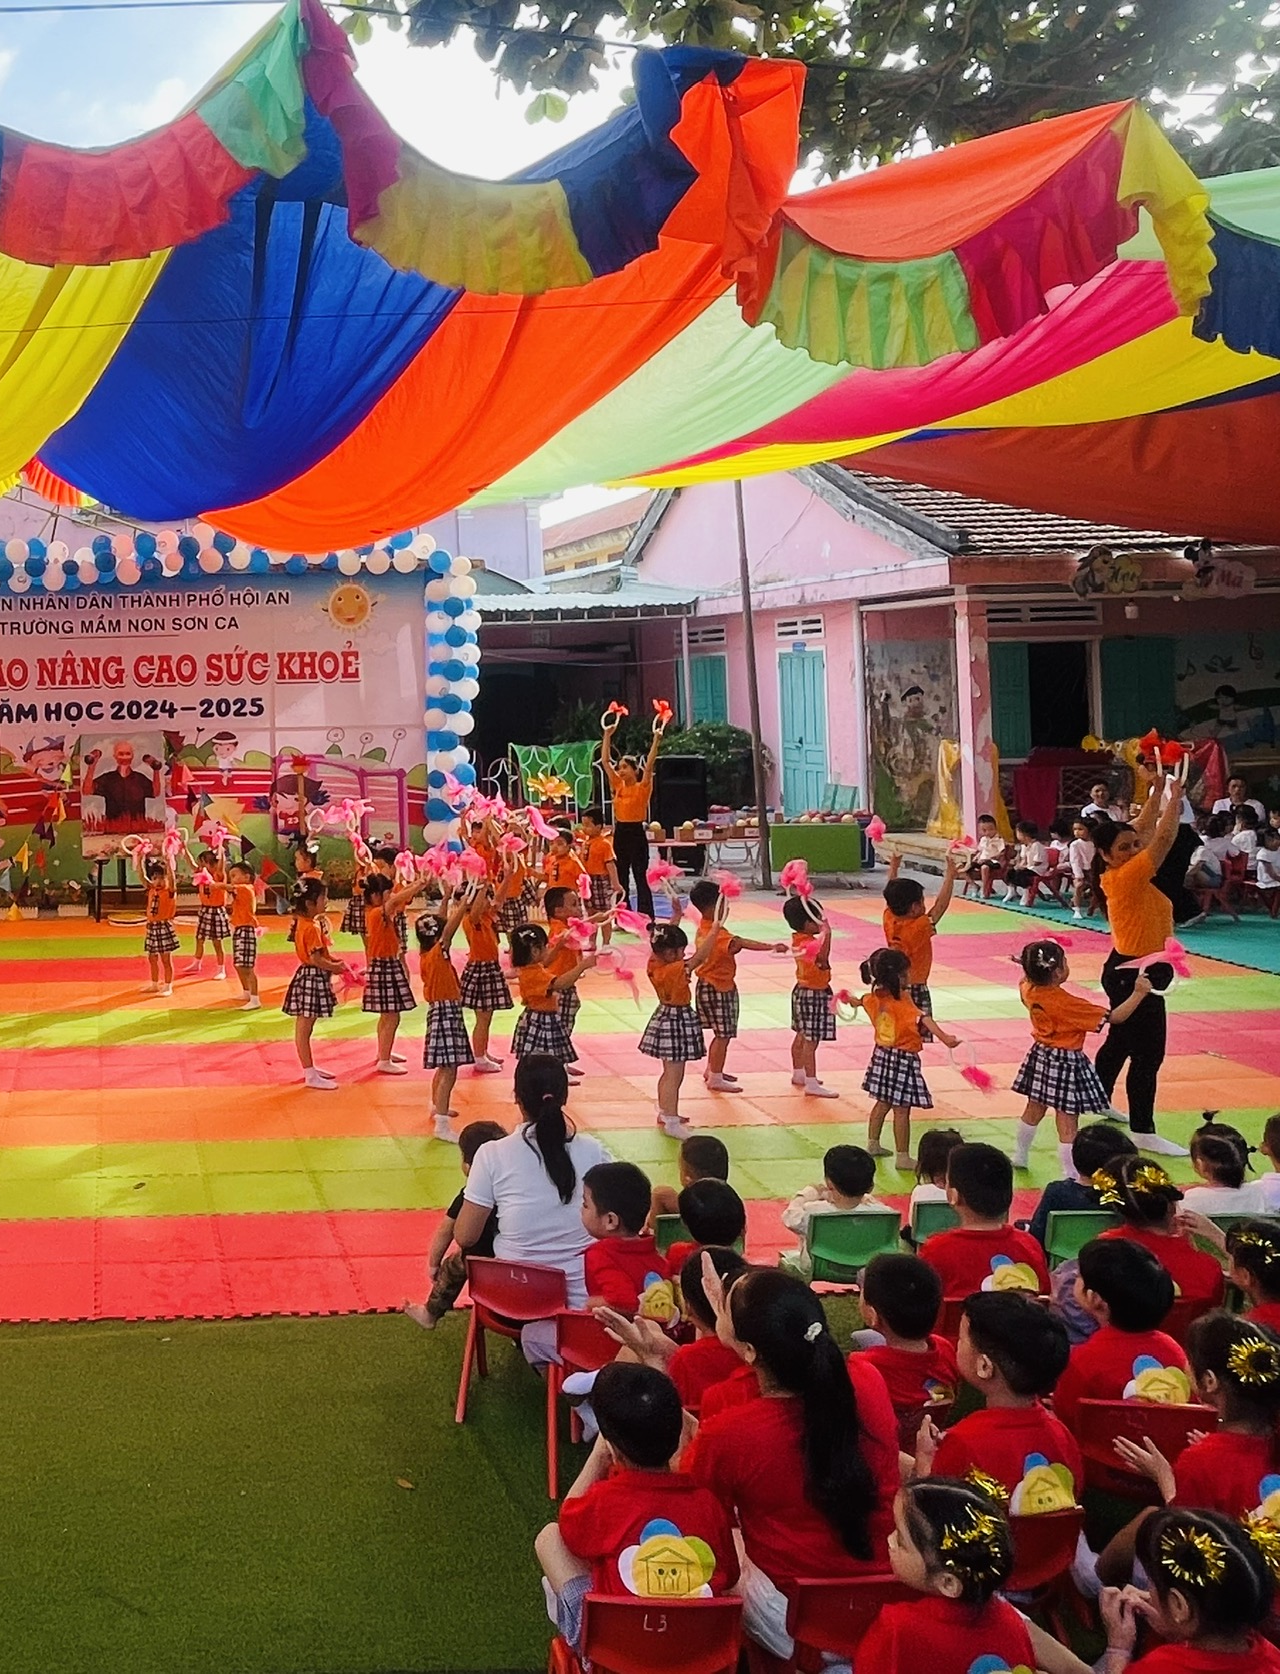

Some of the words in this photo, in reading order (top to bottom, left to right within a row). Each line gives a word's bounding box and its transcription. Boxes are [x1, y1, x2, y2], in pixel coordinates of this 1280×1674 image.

[20, 594, 69, 611] NHÂN
[76, 591, 113, 609] DÂN
[122, 590, 180, 608] THÀNH
[187, 585, 226, 607] PHỐ
[230, 588, 260, 606] HỘI
[265, 592, 290, 605] AN
[128, 618, 165, 632] NON
[171, 616, 208, 631] SƠN
[214, 617, 239, 630] CA
[36, 650, 125, 688] NÂNG
[133, 653, 198, 686] CAO
[205, 645, 270, 684] SỨC
[275, 641, 360, 681] KHOẺ
[44, 701, 105, 728] HỌC
[642, 1614, 668, 1632] L3
